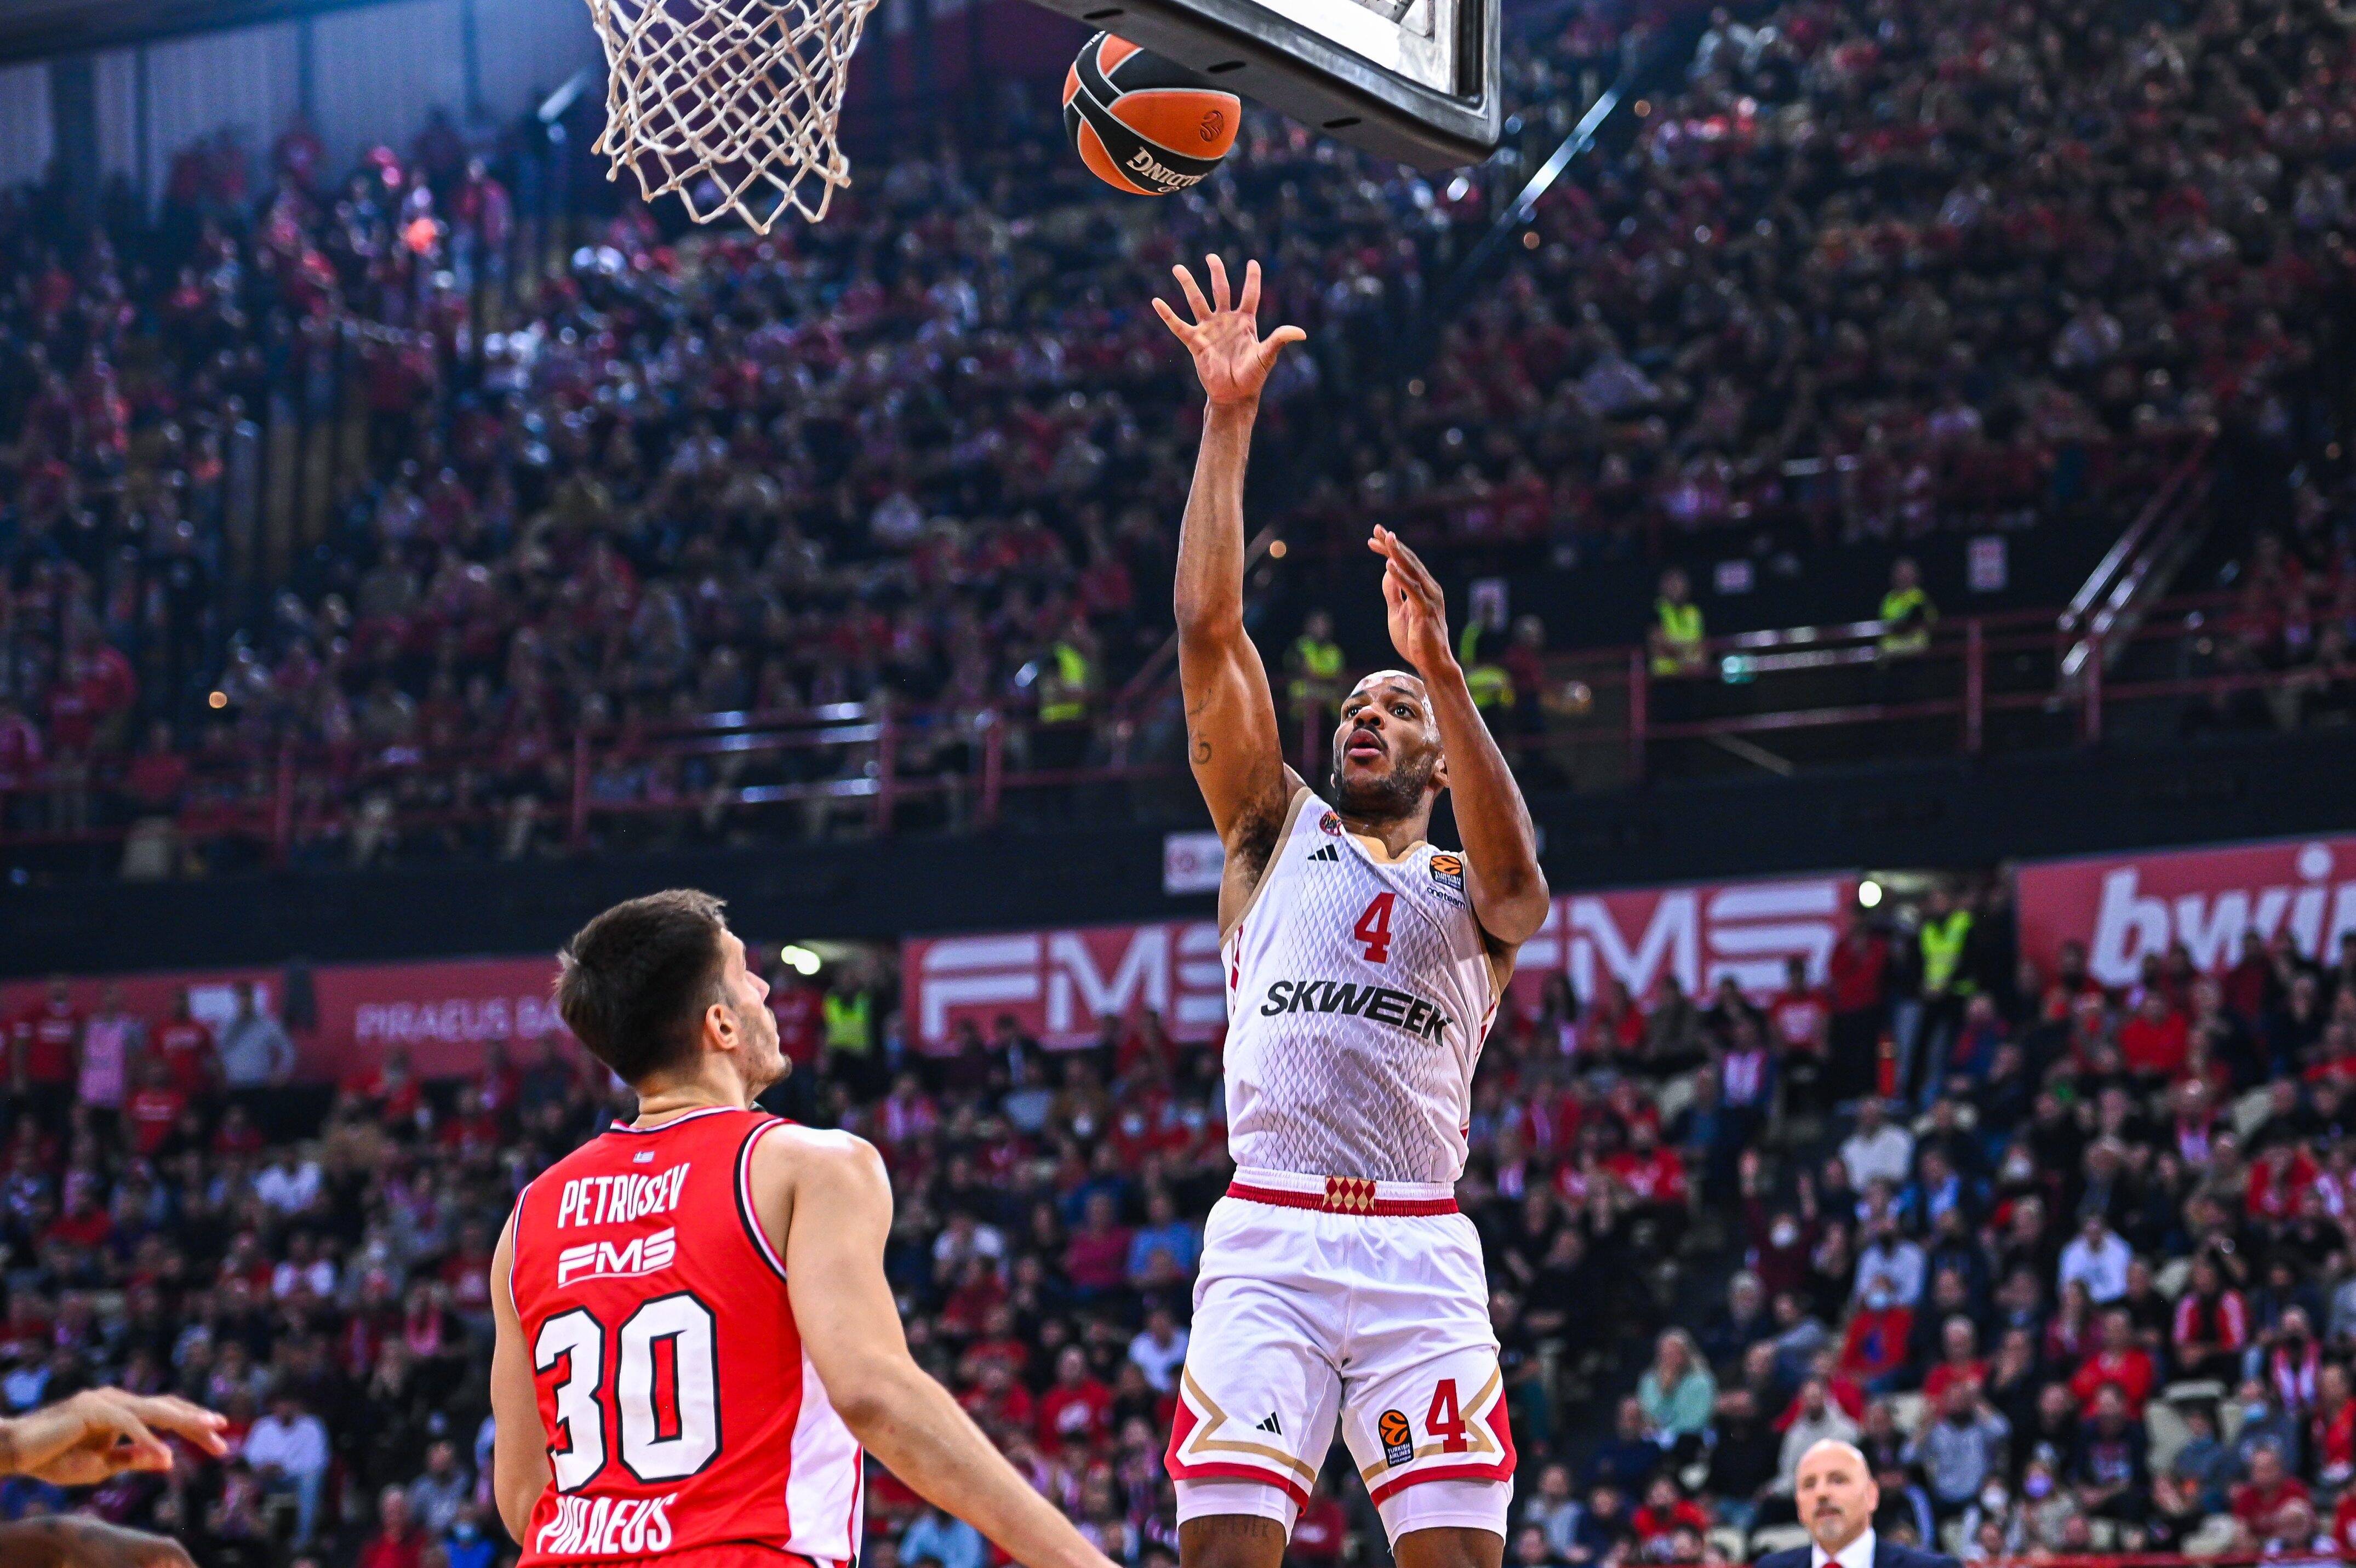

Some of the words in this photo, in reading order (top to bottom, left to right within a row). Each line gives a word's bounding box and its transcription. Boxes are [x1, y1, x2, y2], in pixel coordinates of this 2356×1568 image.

[1354, 891, 1396, 964] 4
[1261, 980, 1454, 1047] SKWEEK
[557, 1161, 690, 1229] PETRUSEV
[557, 1227, 676, 1289] FMS
[533, 1290, 723, 1492] 30
[1425, 1378, 1468, 1453] 4
[1387, 1443, 1410, 1453] TURKISH
[536, 1492, 678, 1554] PIRAEUS
